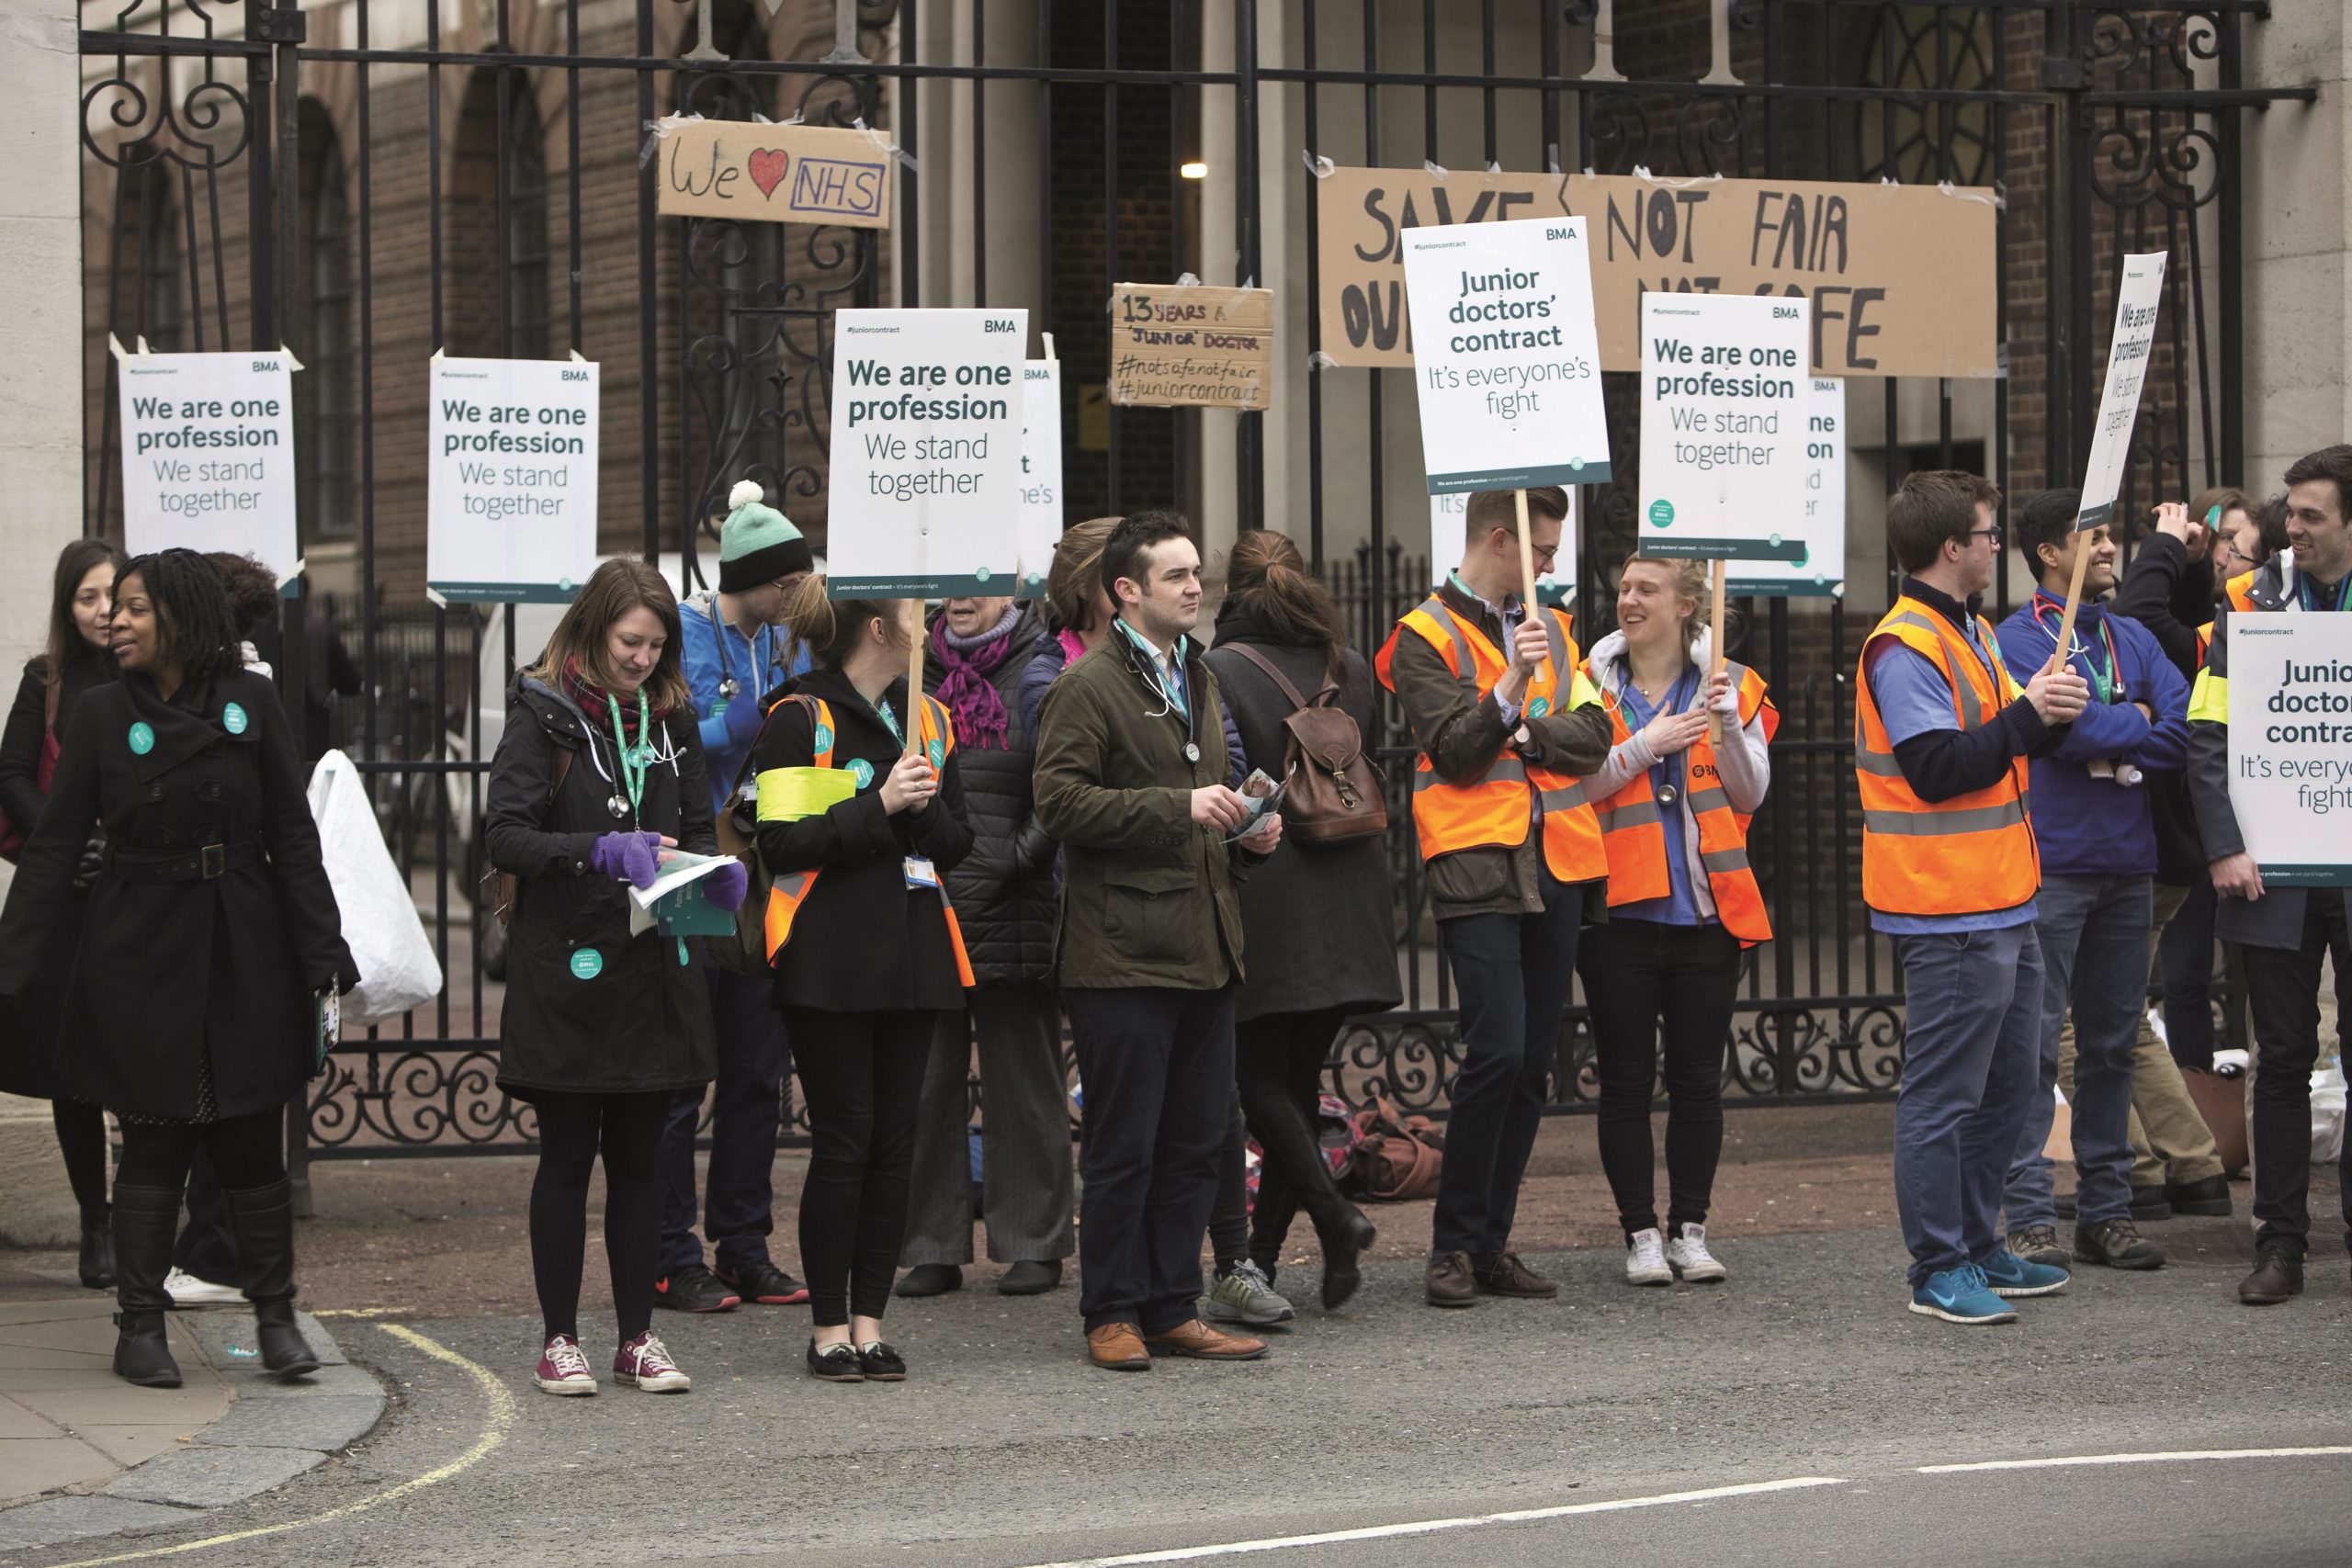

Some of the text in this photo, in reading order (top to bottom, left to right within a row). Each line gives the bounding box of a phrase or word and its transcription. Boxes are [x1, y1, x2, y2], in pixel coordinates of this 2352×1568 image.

[671, 136, 876, 210] We NHS
[1546, 228, 1577, 241] BMA
[1607, 188, 1709, 264] NOT
[1750, 190, 1849, 275] FAIR
[1414, 241, 1466, 251] #juniorcontract
[1460, 267, 1540, 297] Junior
[1123, 295, 1153, 322] 13
[1154, 304, 1206, 322] YEARS
[1341, 280, 1412, 355] OU
[1449, 295, 1556, 323] doctors'
[1772, 307, 1799, 319] BMA
[2120, 303, 2156, 329] We are one
[847, 326, 899, 334] #juniorcontract
[985, 320, 1016, 333] BMA
[1451, 325, 1563, 353] contract
[1204, 333, 1261, 351] DOCTOR
[1654, 338, 1797, 367] We are one
[2112, 333, 2151, 368] profession
[253, 361, 280, 372] BMA
[561, 370, 589, 381] BMA
[847, 359, 1012, 386] We are one
[1024, 369, 1050, 380] BMA
[1117, 354, 1257, 380] #notsafenotfair
[1429, 355, 1590, 389] It's everyone's
[1117, 378, 1260, 400] #juniorcontract
[1656, 372, 1794, 400] profession
[1815, 380, 1837, 391] BMA
[132, 397, 279, 420] We are one
[442, 400, 586, 425] We are one
[849, 393, 1007, 428] profession
[1486, 389, 1540, 419] fight
[1670, 406, 1779, 434] We stand
[1809, 416, 1836, 432] ne
[137, 423, 279, 455] profession
[445, 430, 584, 457] profession
[865, 433, 988, 460] We stand
[1674, 440, 1775, 470] together
[153, 457, 265, 482] We stand
[459, 462, 568, 487] We stand
[869, 468, 983, 502] together
[160, 488, 262, 517] together
[463, 492, 564, 521] together
[2239, 628, 2293, 637] #juniorcontract
[2282, 659, 2352, 687] Junio
[2267, 690, 2352, 713] docto
[2266, 722, 2352, 743] contra
[2241, 754, 2352, 784] It's every
